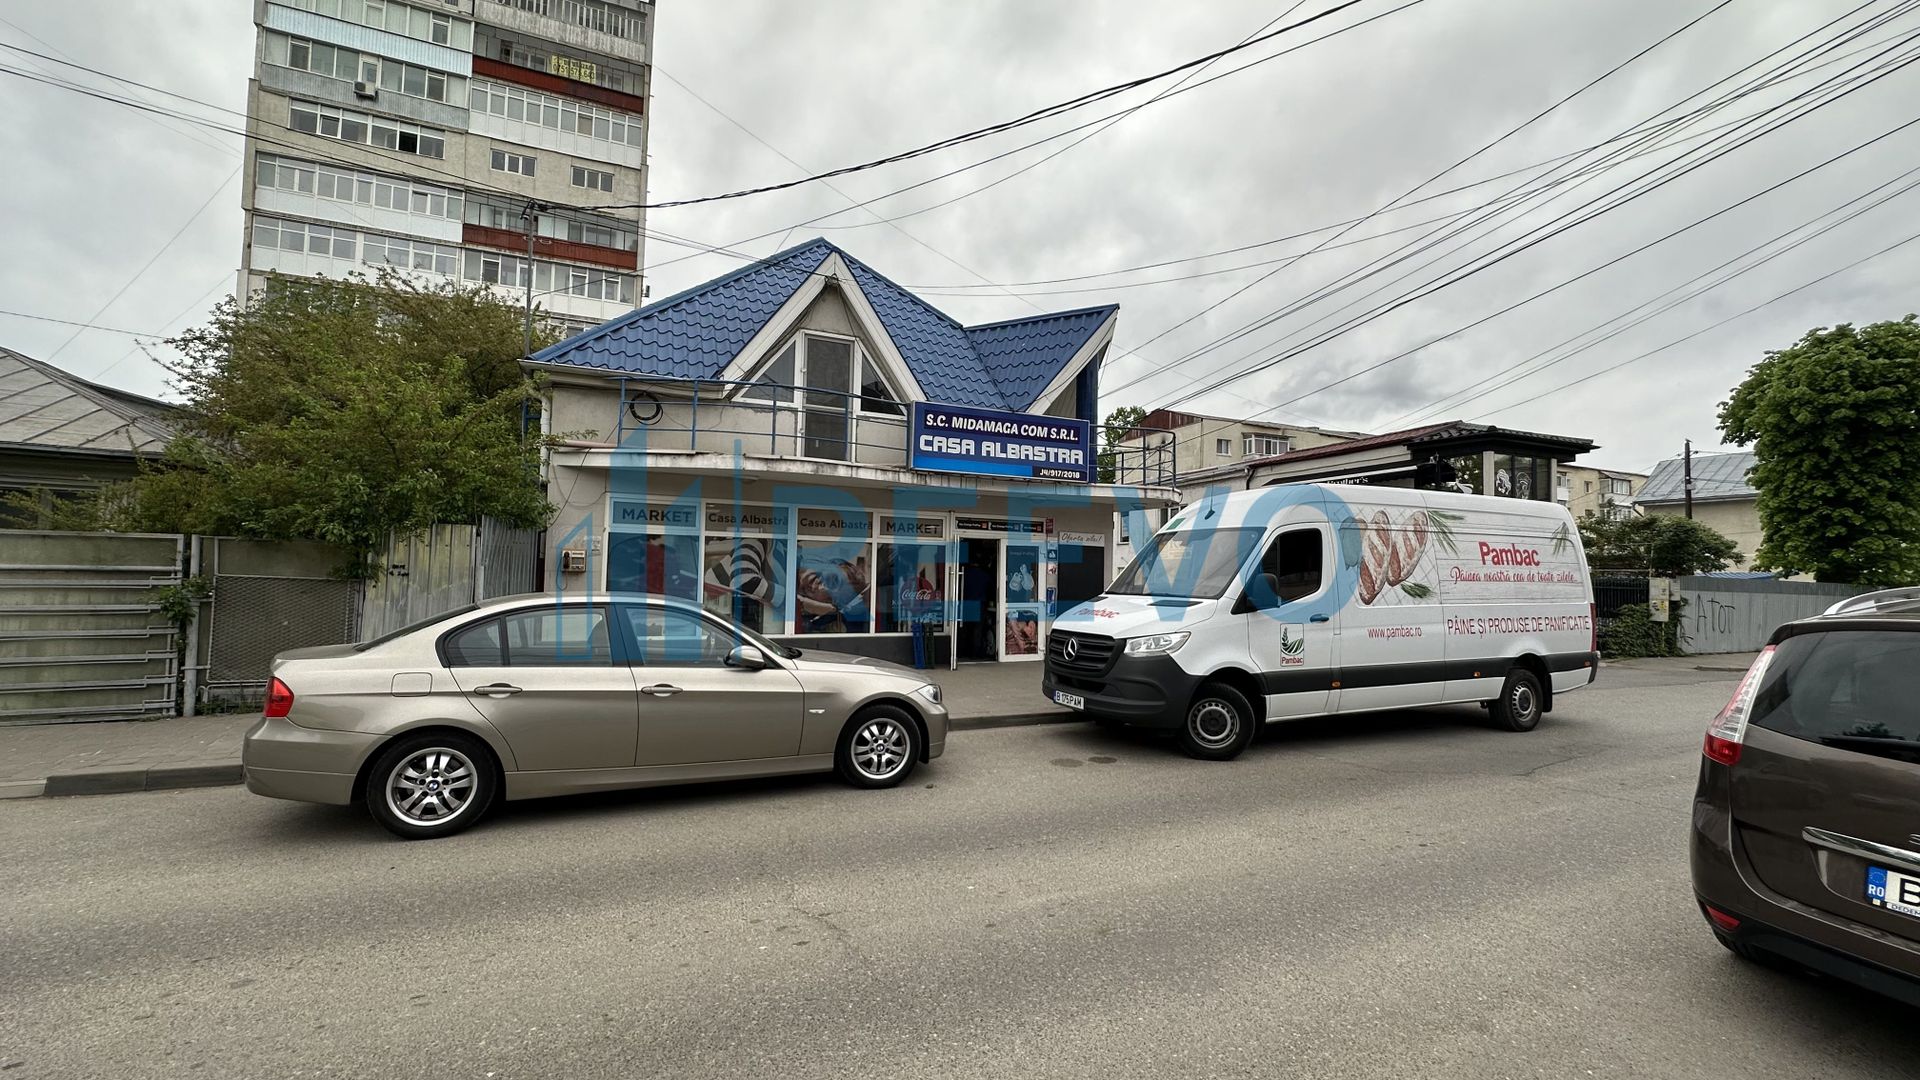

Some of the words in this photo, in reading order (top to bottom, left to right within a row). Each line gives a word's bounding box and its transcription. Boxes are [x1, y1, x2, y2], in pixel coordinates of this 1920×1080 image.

[925, 413, 948, 428] S.C.
[951, 416, 1018, 435] MIDAMAGA
[1020, 424, 1048, 438] COM
[1050, 427, 1079, 441] S.R.L.
[919, 434, 974, 456] CASA
[981, 441, 1083, 465] ALBASTRA
[1039, 468, 1080, 479] J4/917/2018
[621, 508, 692, 523] MARKET
[708, 513, 737, 523] Casa
[800, 518, 826, 528] Casa
[886, 521, 941, 534] MARKET
[1478, 541, 1540, 566] Pambac
[1526, 570, 1536, 582] de
[1448, 615, 1476, 635] PÂINE
[1488, 617, 1531, 634] PRODUSE
[1532, 617, 1543, 632] DE
[1544, 615, 1590, 634] PANIFICAȚIE
[1367, 625, 1422, 641] www.pambac.ro
[1281, 656, 1303, 665] Pambac
[1868, 884, 1885, 898] RO
